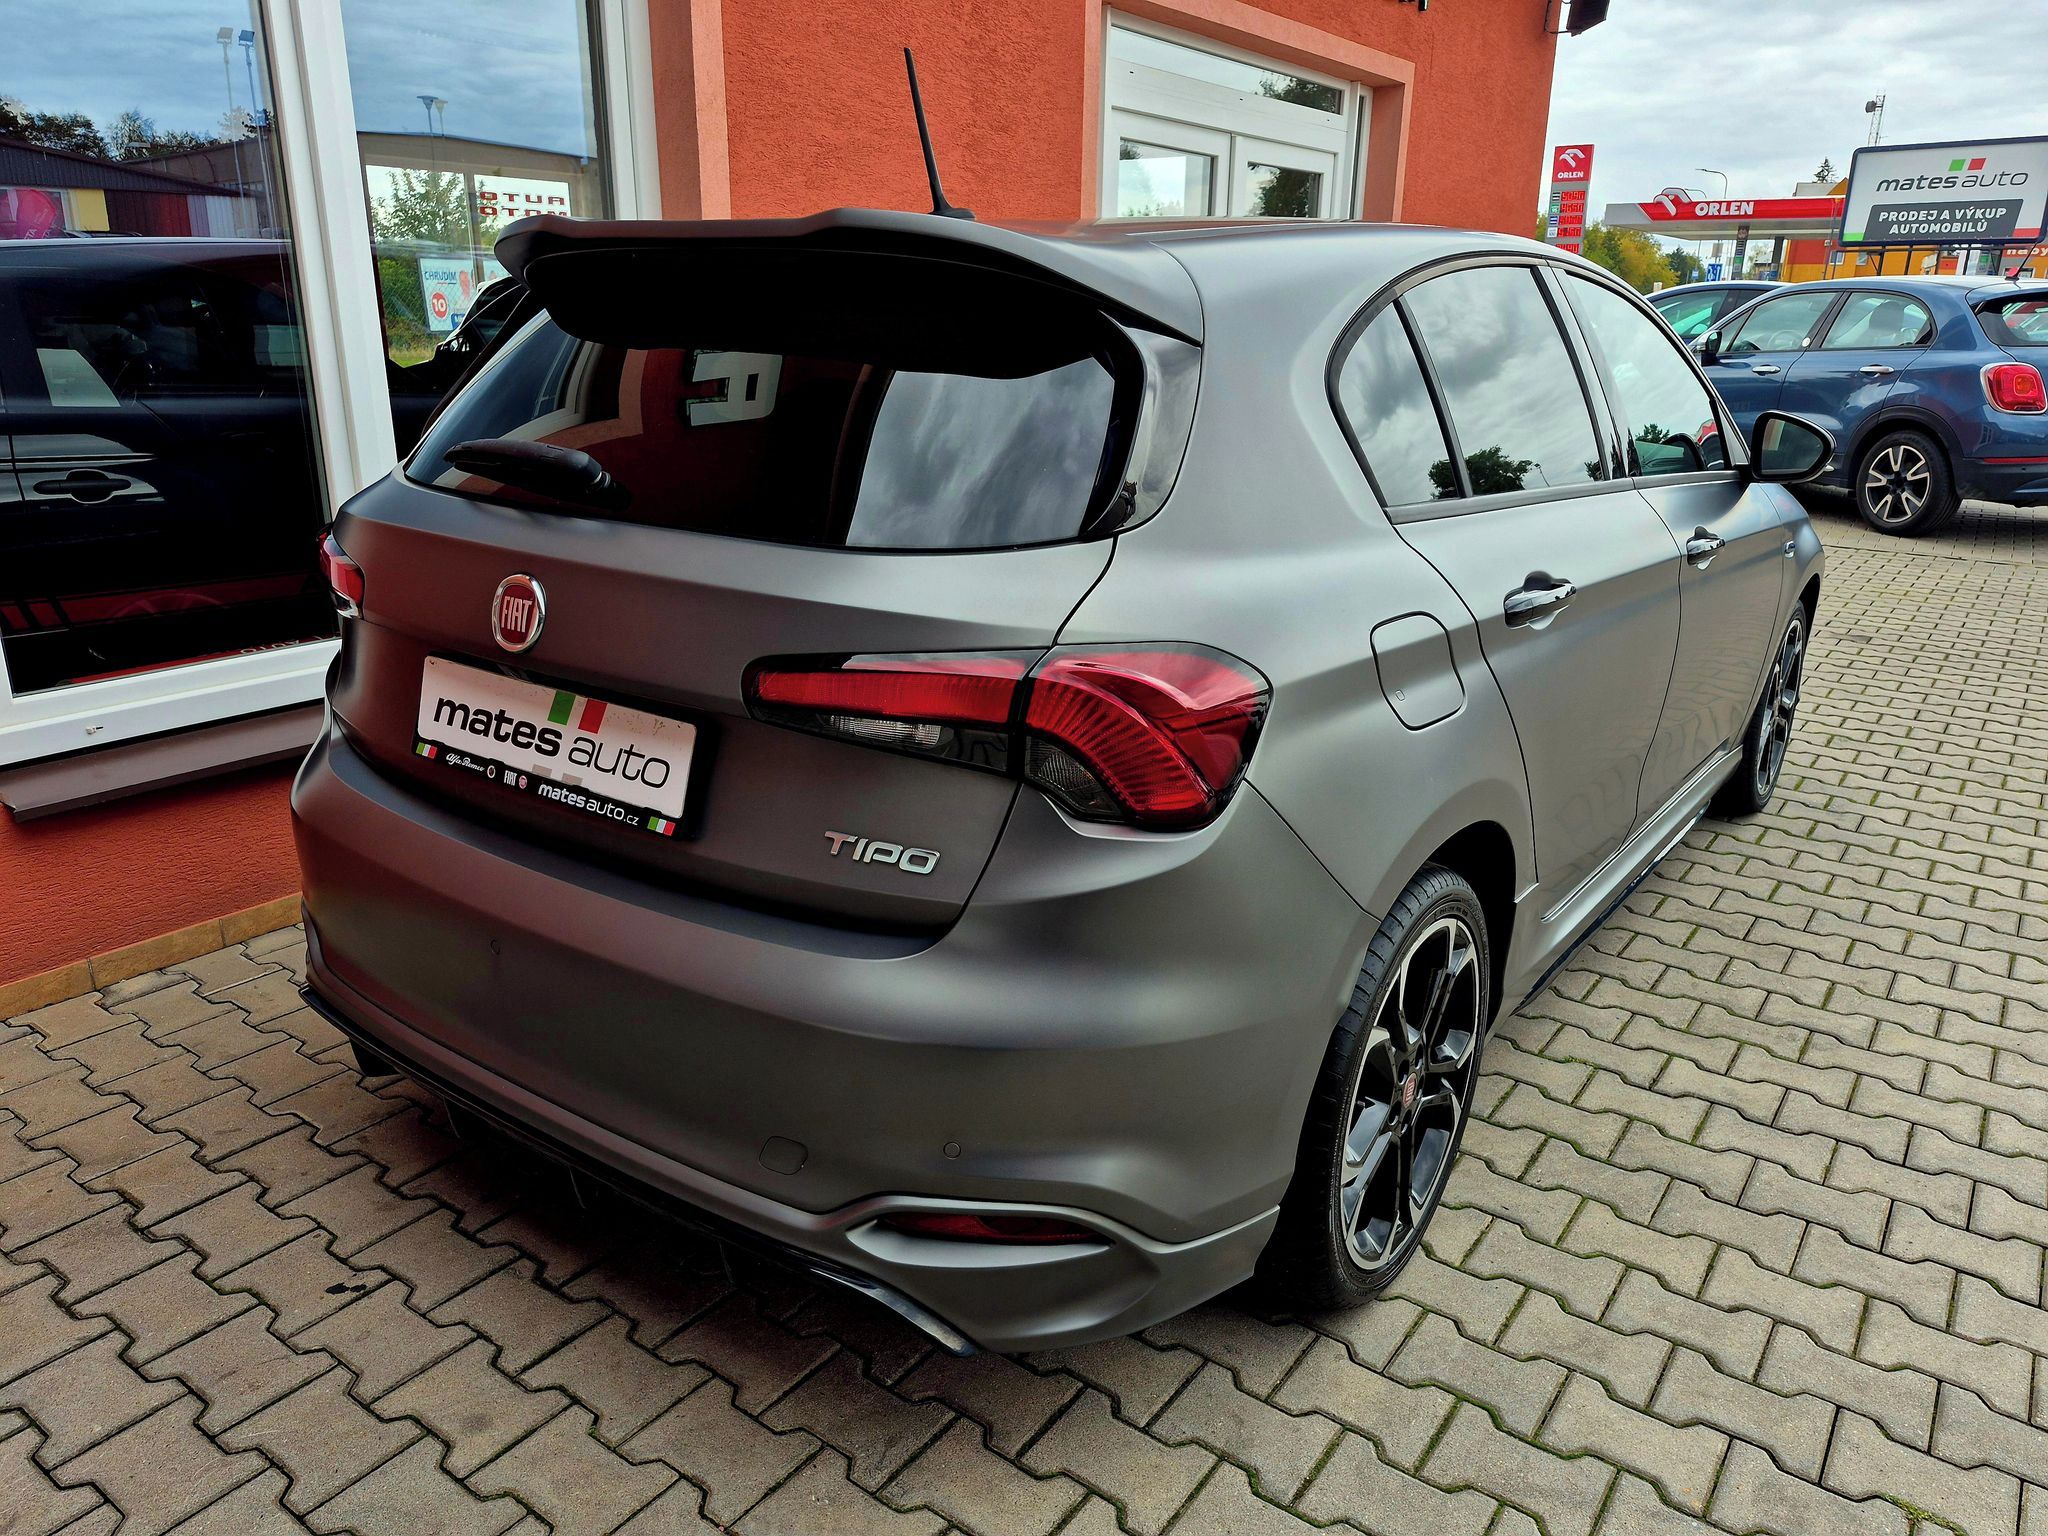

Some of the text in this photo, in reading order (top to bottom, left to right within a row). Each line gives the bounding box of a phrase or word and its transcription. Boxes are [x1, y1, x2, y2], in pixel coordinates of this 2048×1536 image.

[1558, 171, 1584, 179] ORLEN
[1875, 171, 2029, 192] mates auto
[1695, 201, 1755, 216] ORLEN
[1879, 206, 2007, 222] PRODEJ A VÝKUP
[1889, 219, 1988, 235] AUTOMOBILŮ
[424, 271, 457, 281] CHRUDIM
[432, 298, 447, 312] 10
[501, 596, 533, 633] FIAT
[433, 696, 671, 789] mates auto
[503, 769, 518, 786] FIAT
[824, 830, 941, 875] TIPO
